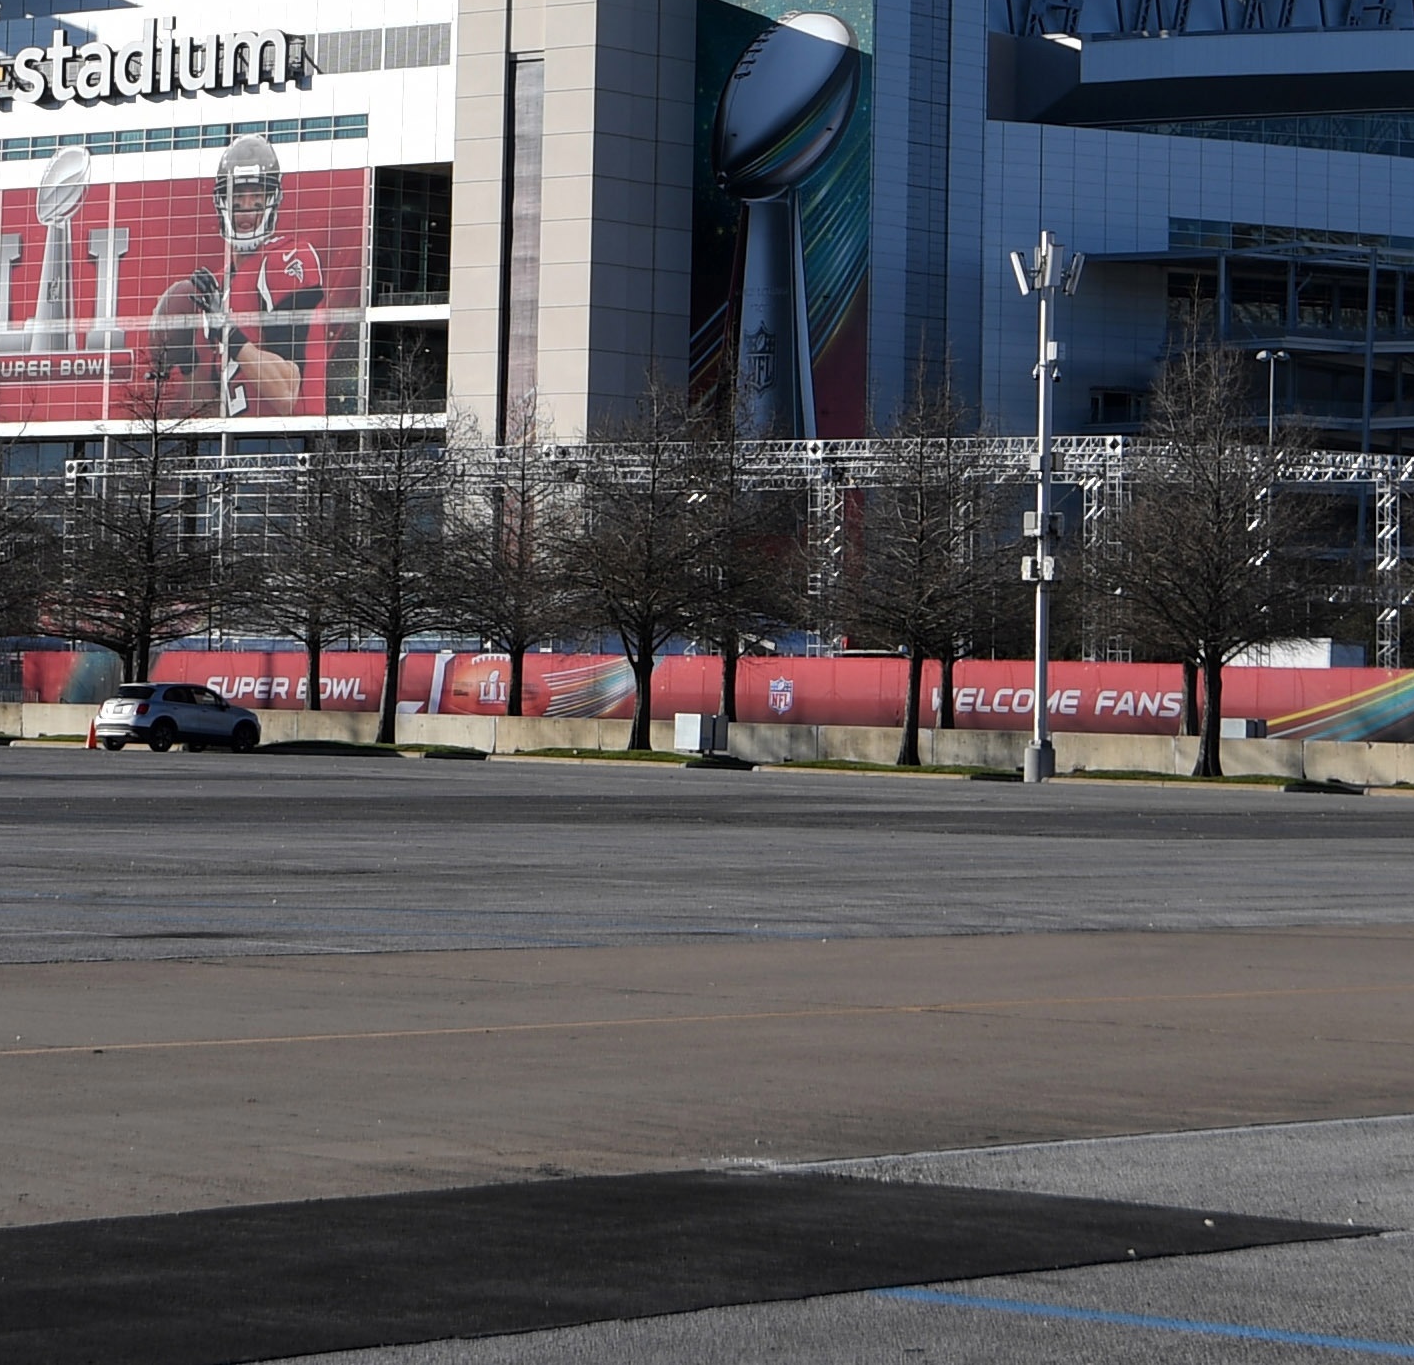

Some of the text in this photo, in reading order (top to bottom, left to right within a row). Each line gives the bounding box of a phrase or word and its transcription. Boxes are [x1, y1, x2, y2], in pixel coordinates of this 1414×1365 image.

[12, 16, 288, 104] stadium
[60, 359, 114, 376] BOWL
[206, 676, 366, 701] SUPER BOWL
[770, 692, 792, 709] NFL
[931, 687, 1183, 717] WELCOME FANS
